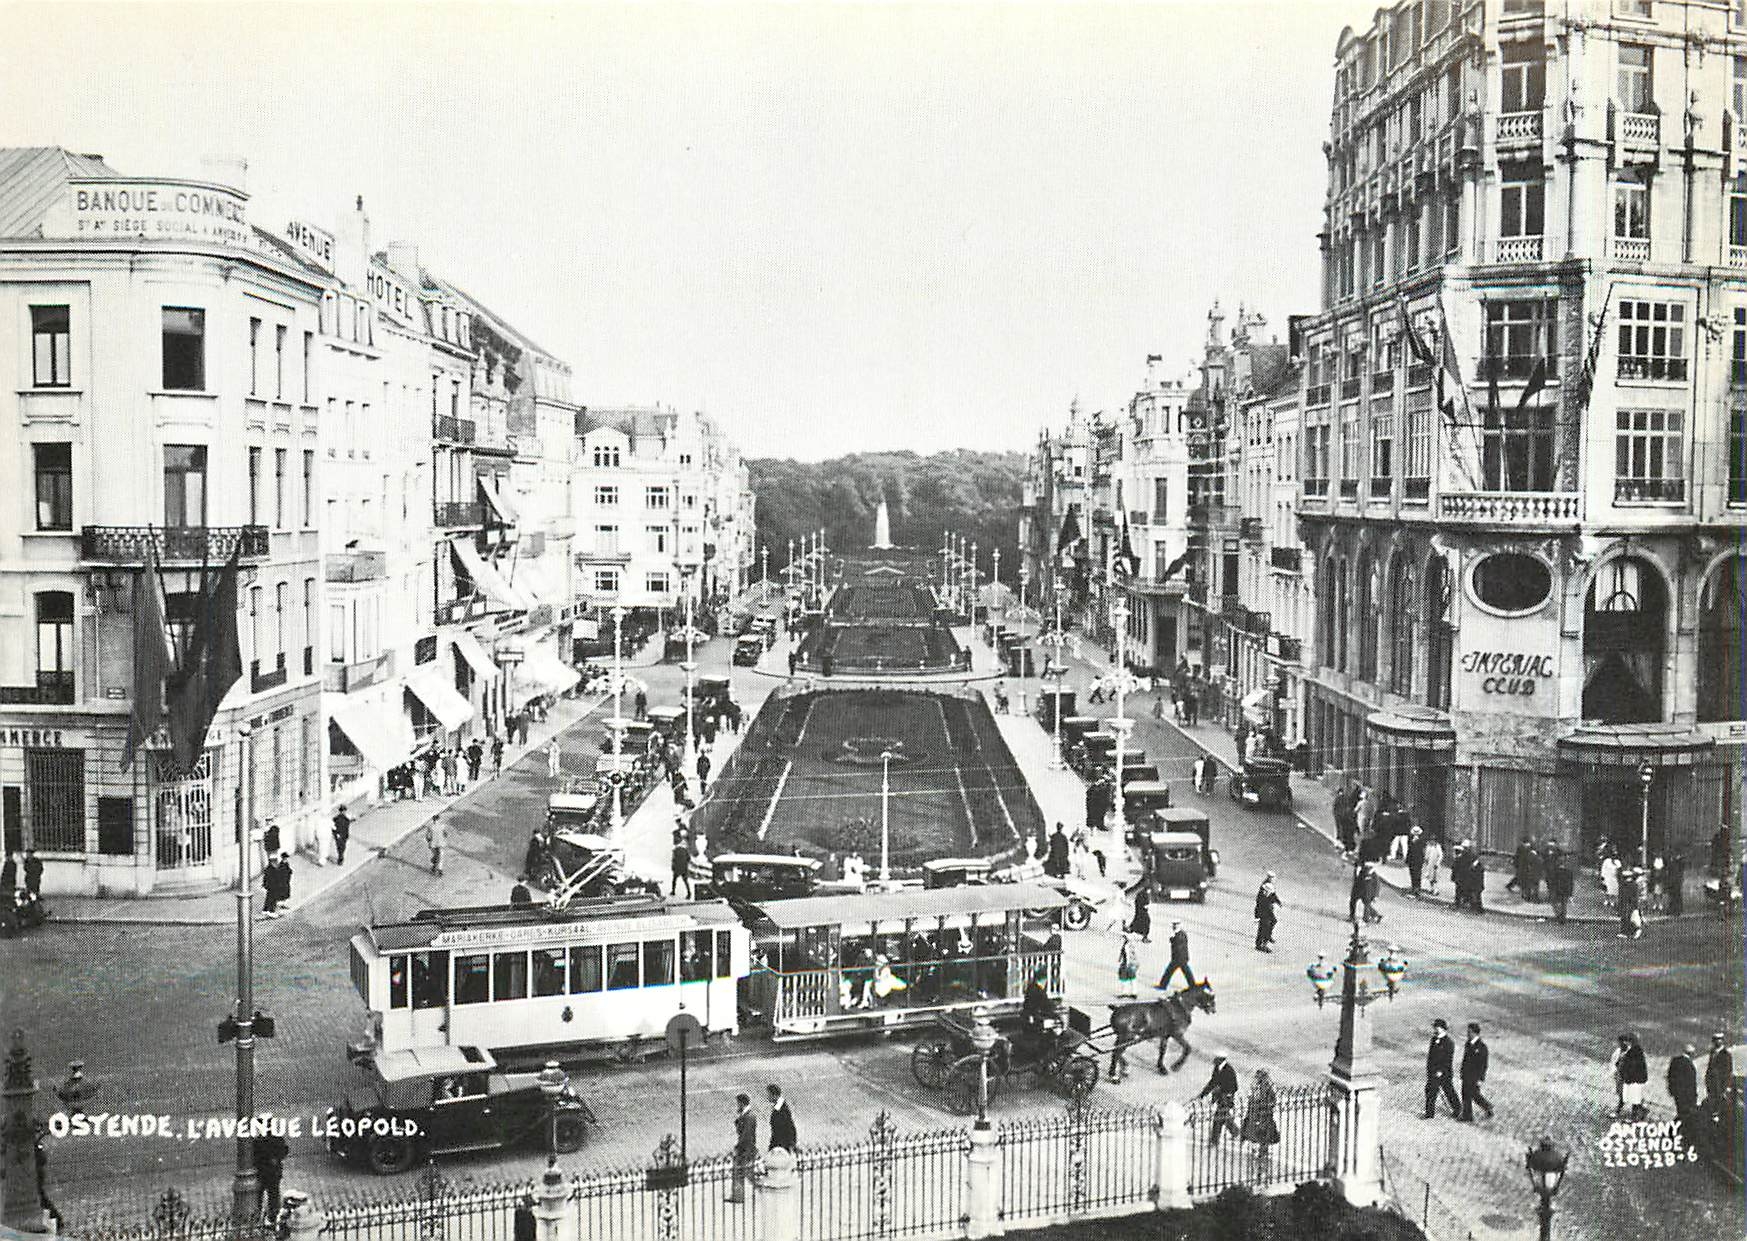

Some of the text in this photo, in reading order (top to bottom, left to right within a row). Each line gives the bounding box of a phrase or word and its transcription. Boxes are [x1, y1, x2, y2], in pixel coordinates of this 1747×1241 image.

[77, 190, 158, 212] BANQUE
[156, 219, 198, 234] SOCIAL
[286, 221, 331, 261] AVENUE
[366, 267, 413, 320] HOTEL
[1461, 651, 1553, 678] IMPERIAL
[1482, 677, 1535, 696] CLUB
